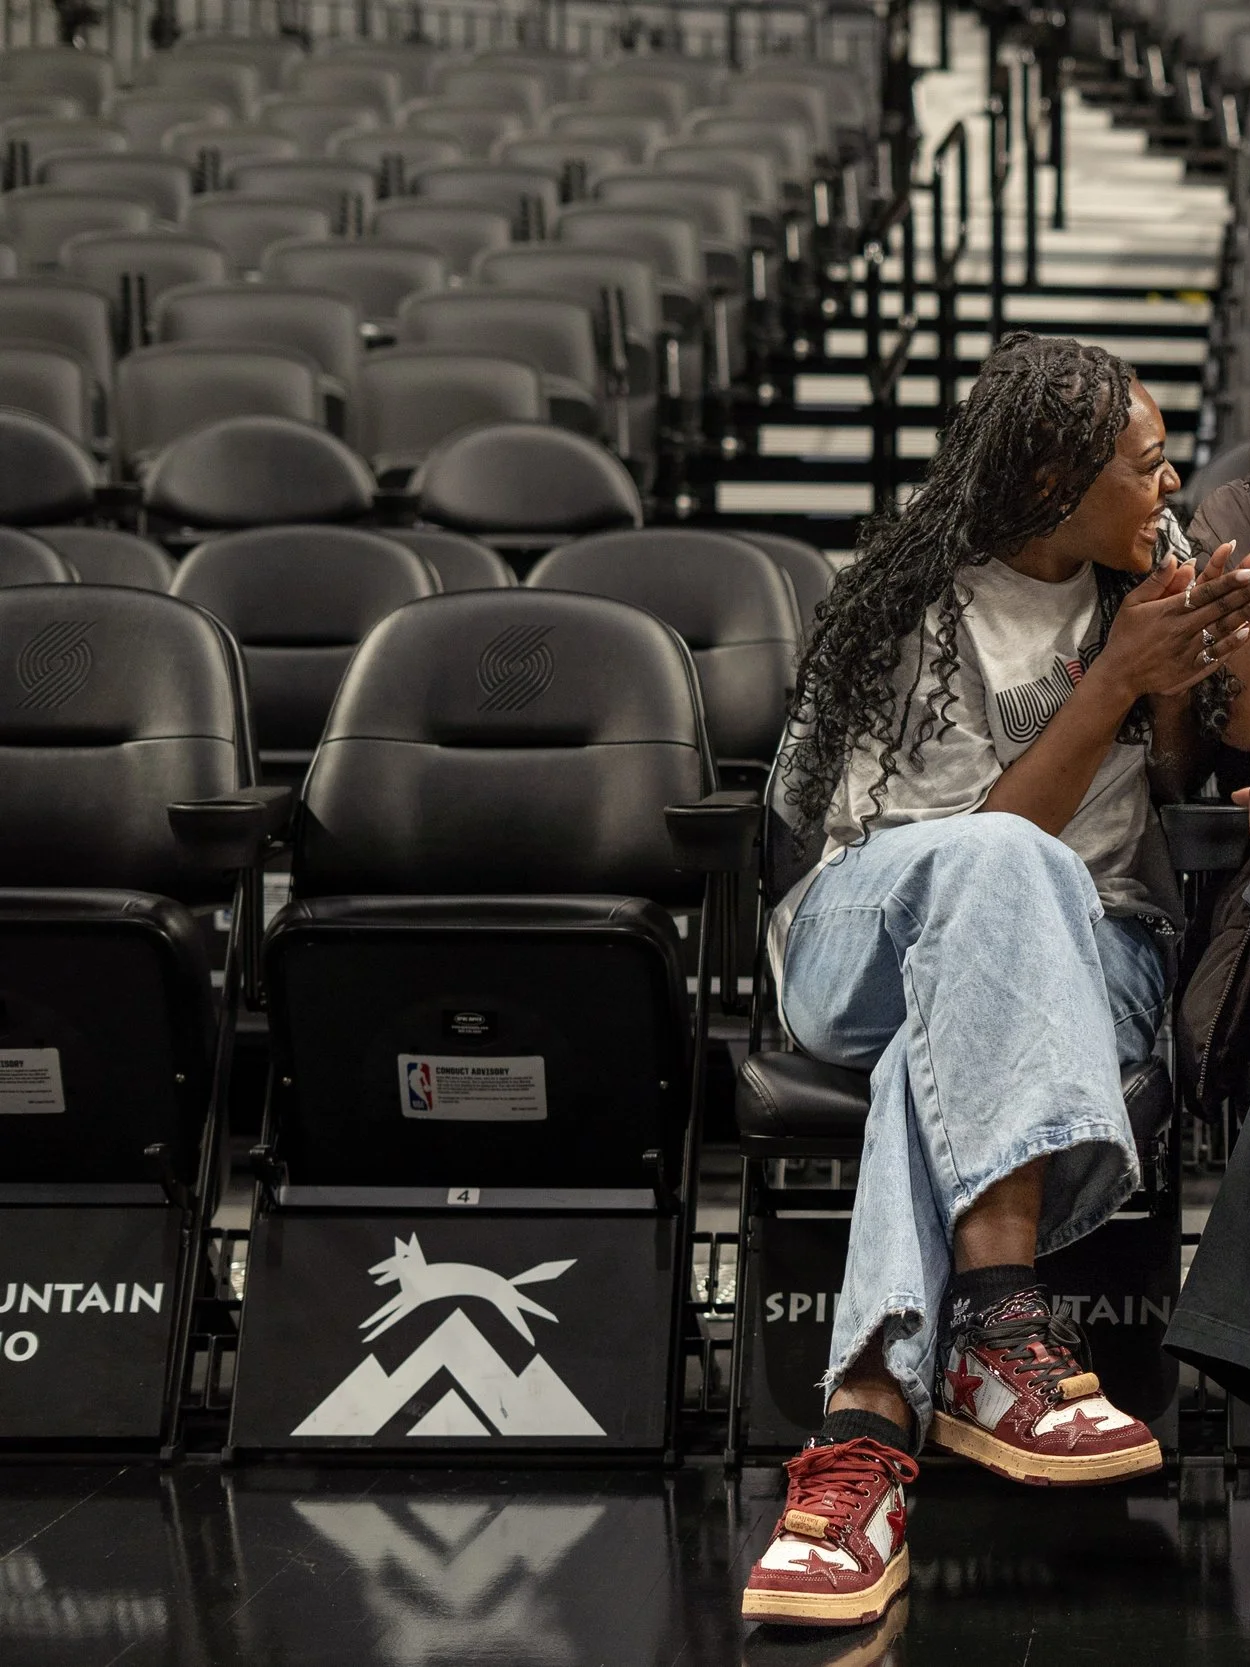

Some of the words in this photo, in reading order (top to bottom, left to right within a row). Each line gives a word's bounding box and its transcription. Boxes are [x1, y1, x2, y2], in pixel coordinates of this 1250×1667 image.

[435, 1067, 469, 1075] CONDUCT
[471, 1067, 510, 1075] ADVISORY
[457, 1190, 470, 1203] 4
